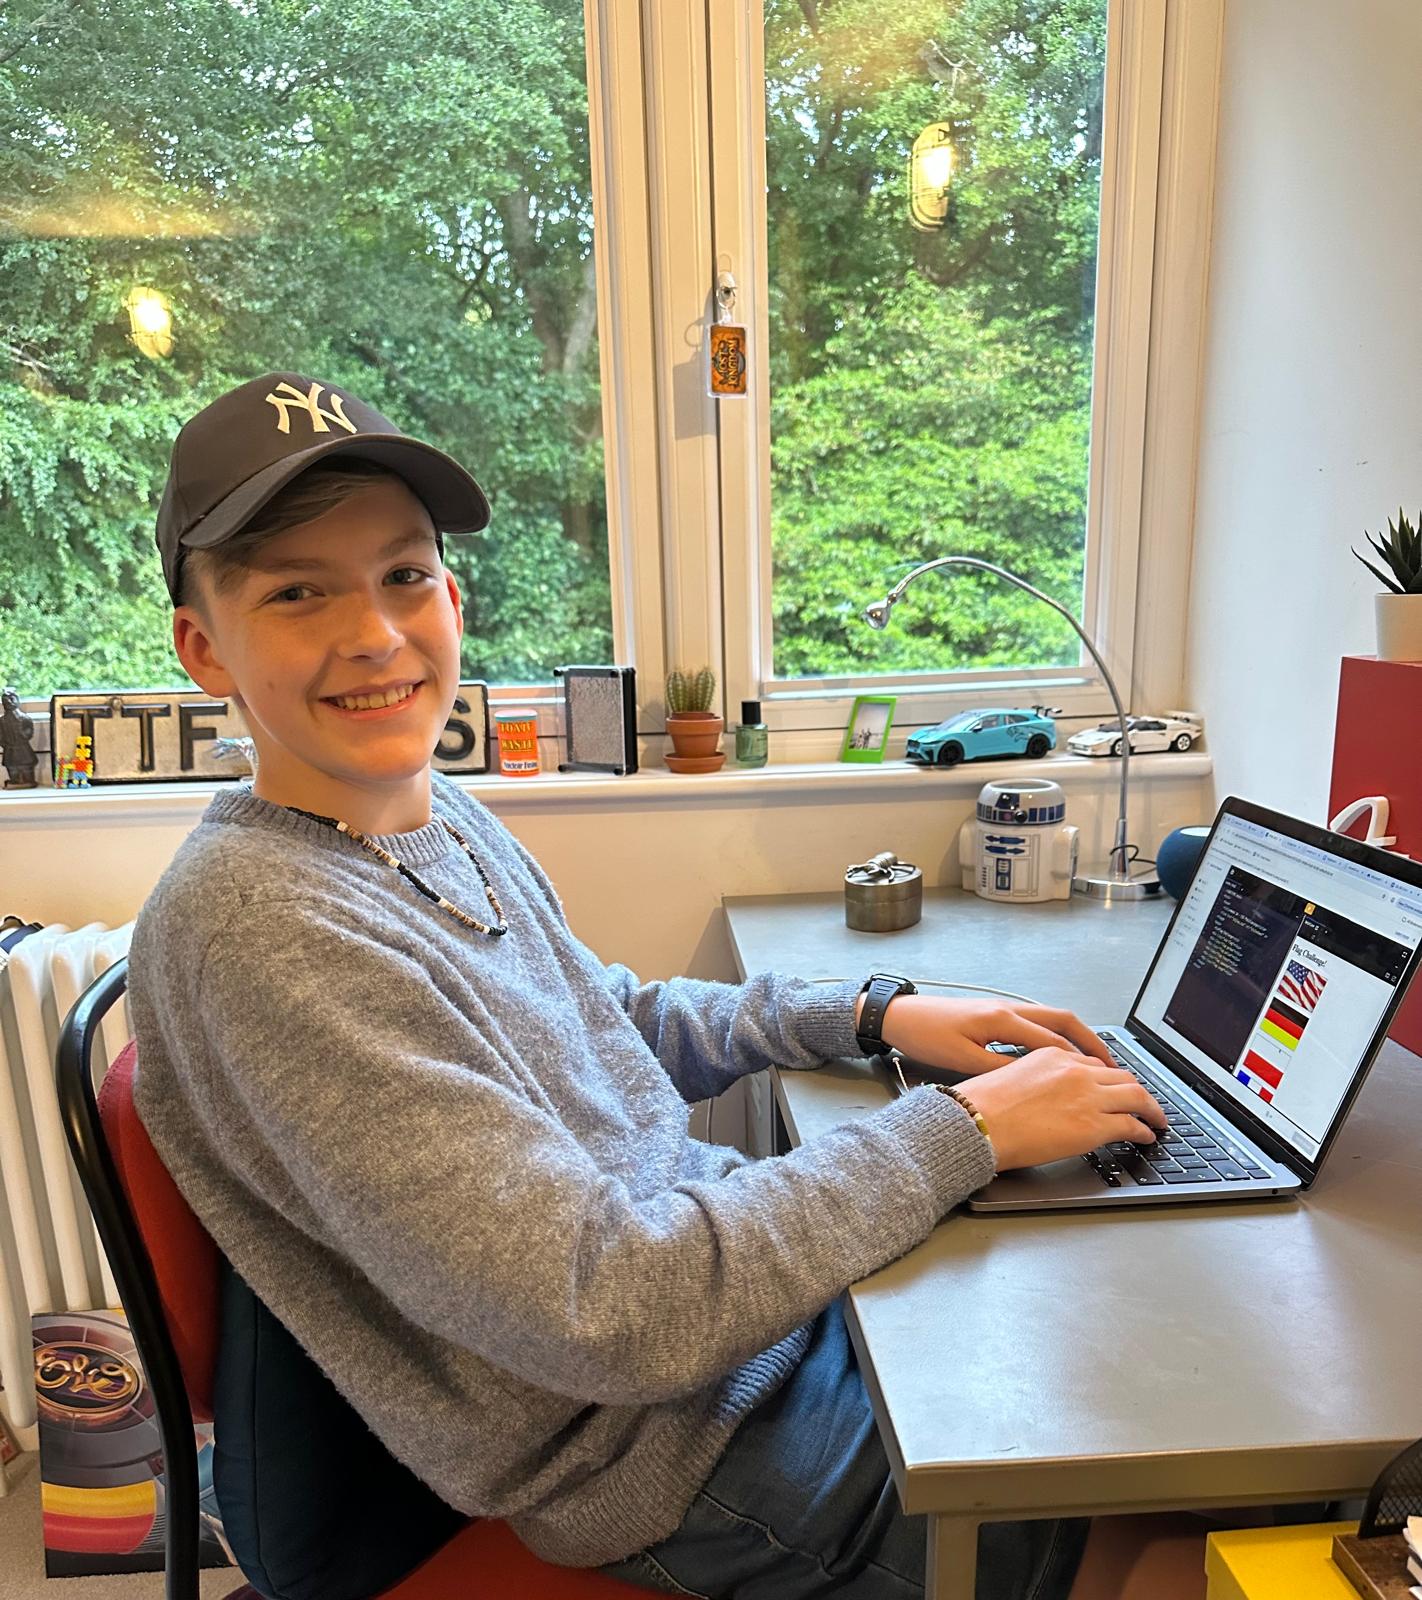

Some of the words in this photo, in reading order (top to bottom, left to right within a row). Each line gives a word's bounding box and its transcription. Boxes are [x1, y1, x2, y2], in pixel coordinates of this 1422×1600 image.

[727, 339, 738, 386] KINGDOM
[265, 382, 357, 434] NY
[62, 702, 228, 772] TTF
[501, 739, 533, 750] WASTE
[1291, 943, 1303, 956] Flag
[1302, 949, 1328, 968] Challenge!
